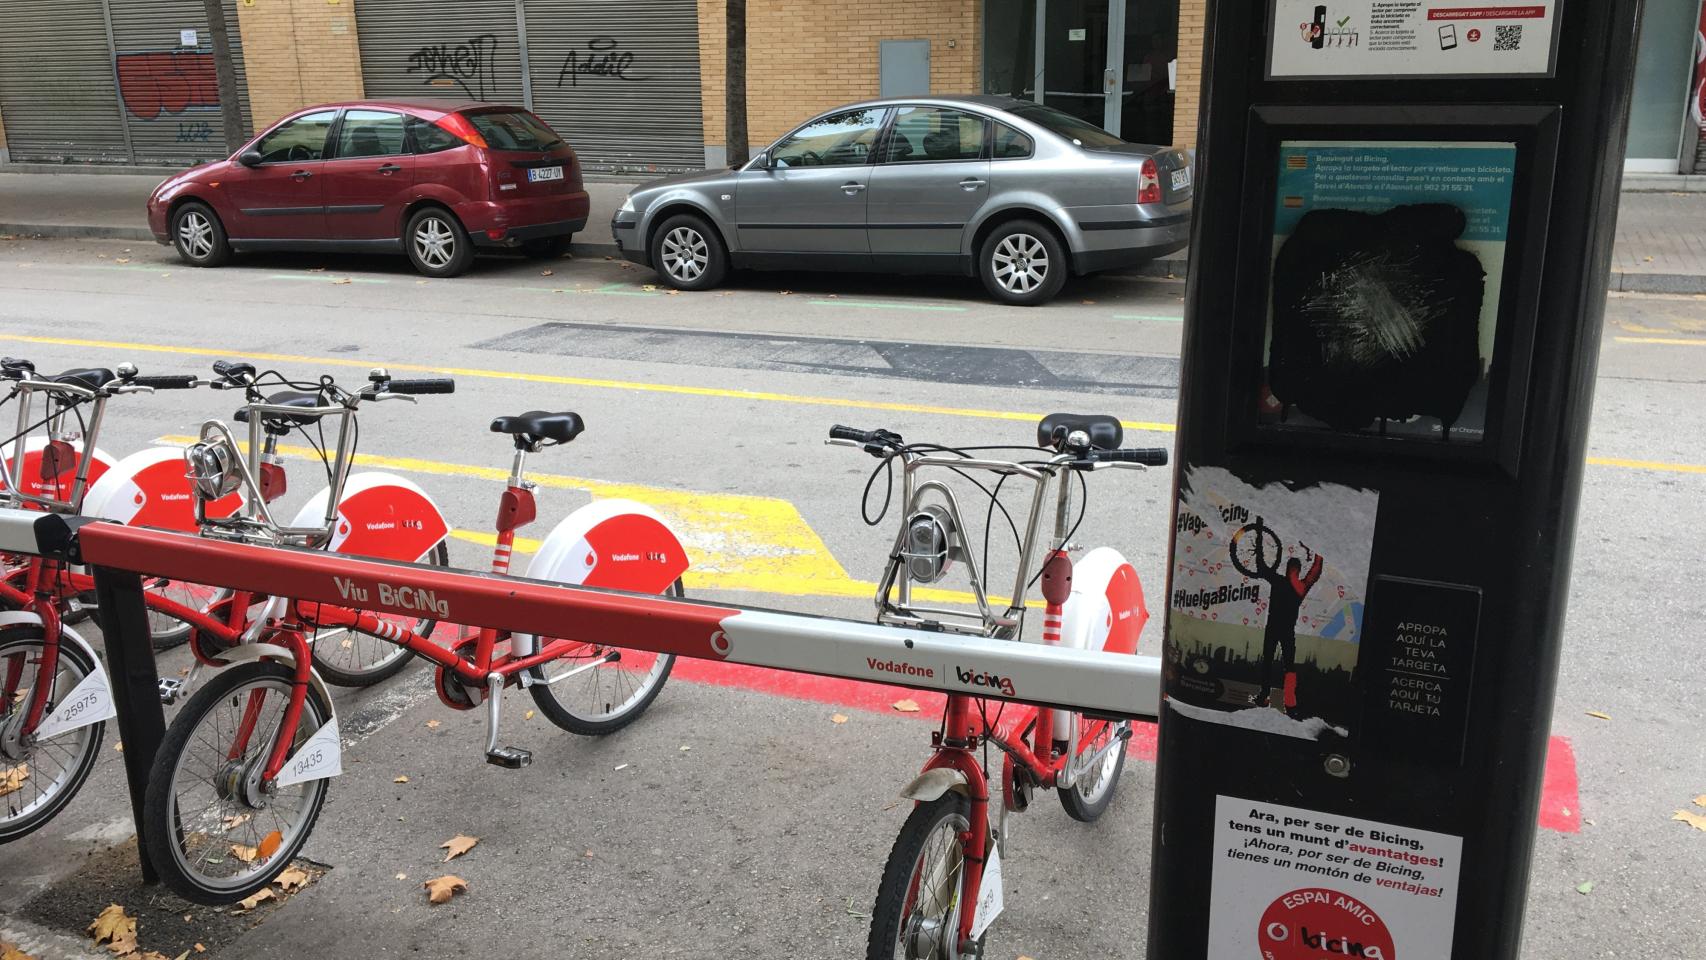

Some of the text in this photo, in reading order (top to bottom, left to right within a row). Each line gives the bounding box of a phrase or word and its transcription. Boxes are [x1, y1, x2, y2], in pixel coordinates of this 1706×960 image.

[1316, 155, 1353, 163] Benvingut
[1364, 155, 1389, 164] Bicing.
[1315, 164, 1342, 173] Apropa
[366, 522, 395, 530] Vodafone
[612, 553, 640, 561] Vodafone
[333, 576, 451, 619] Viu BiCiNg
[1174, 583, 1260, 610] #HuelgaBicing
[1397, 621, 1448, 636] APROPA
[1396, 633, 1446, 648] AQUÍ LA
[1405, 647, 1436, 659] TEVA
[1392, 657, 1446, 673] TARGETA
[867, 657, 1016, 696] Vodafone bicing
[1392, 677, 1442, 692] ACERCA
[1390, 688, 1441, 704] AQUÍ TU
[64, 693, 97, 721] 25975
[1389, 700, 1441, 716] TARJETA
[293, 749, 323, 777] 13435
[1229, 819, 1262, 834] tens
[1266, 827, 1286, 838] un
[1290, 831, 1330, 849] munt
[1248, 808, 1424, 851] Ara, per ser de Bicing,
[1243, 836, 1426, 880] ¡Ahora, por ser de Bicing,
[1227, 848, 1444, 898] tienes un montón de ventajas!
[1282, 892, 1376, 926] ESPAI AMIC
